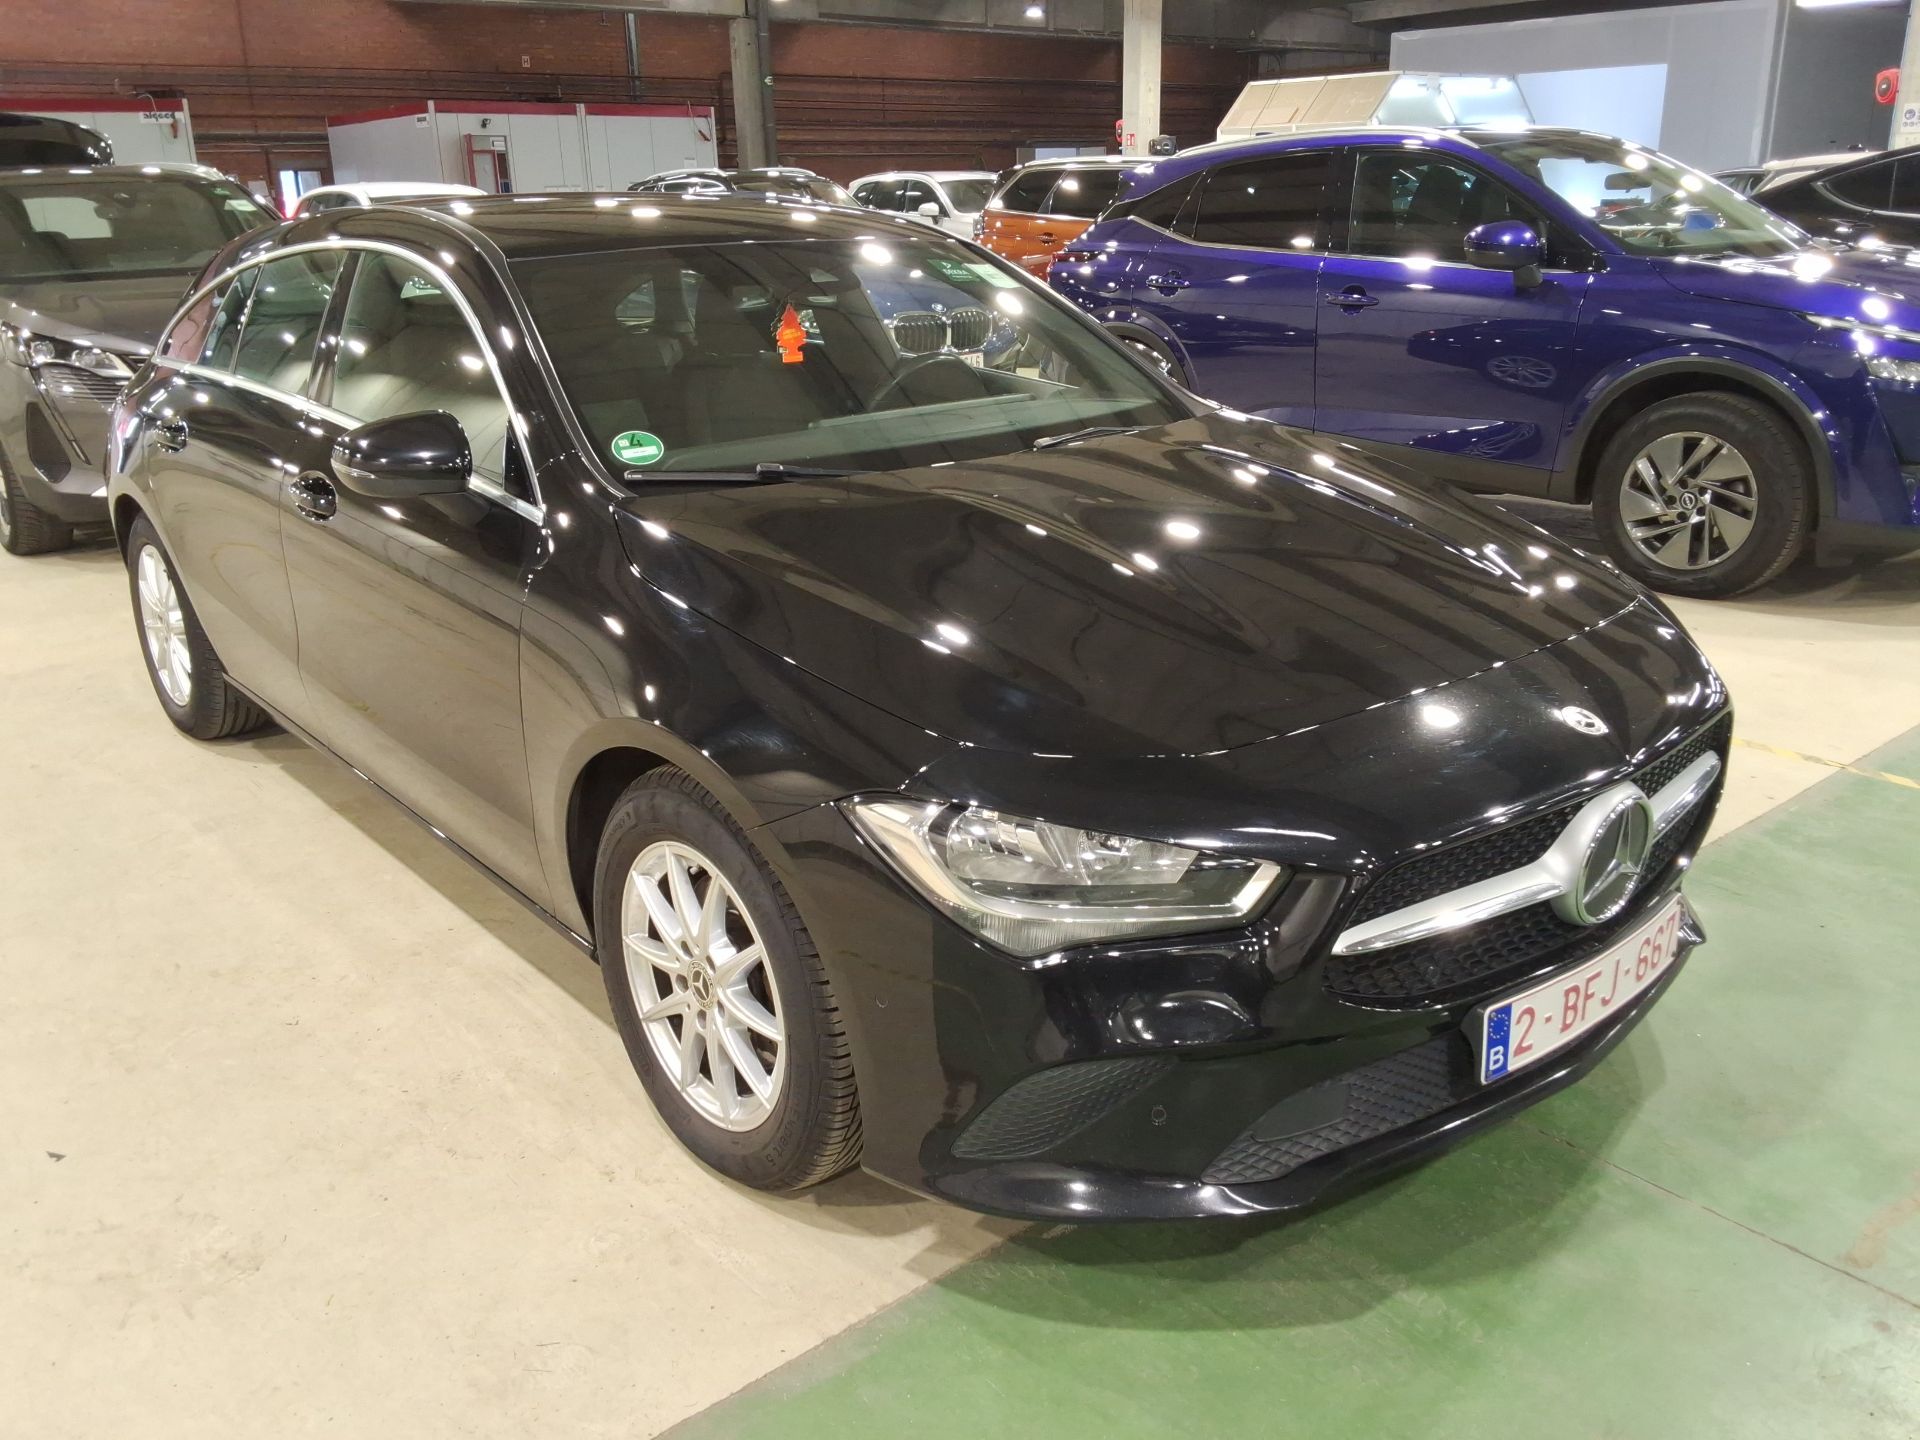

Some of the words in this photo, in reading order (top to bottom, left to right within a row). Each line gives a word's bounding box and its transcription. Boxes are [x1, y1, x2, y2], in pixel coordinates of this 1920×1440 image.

[629, 433, 643, 447] 4
[1513, 913, 1677, 1058] 2-BFJ-667
[1489, 1045, 1504, 1070] B
